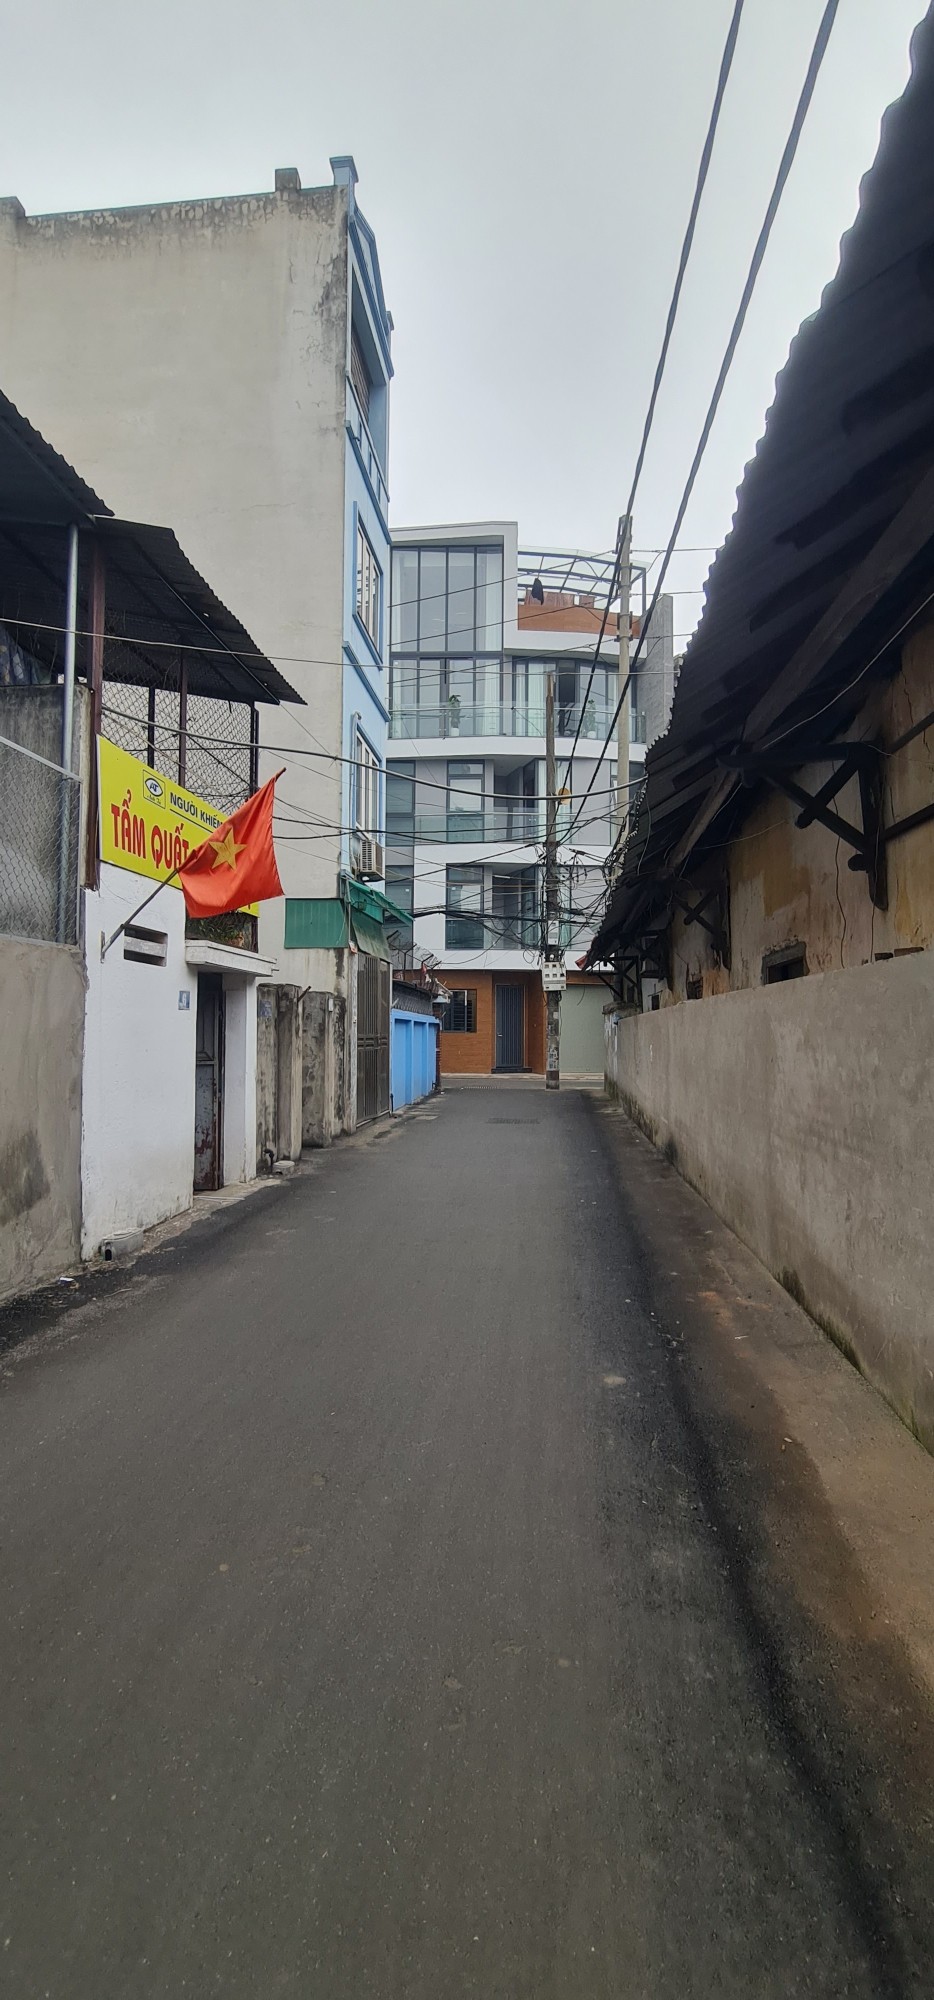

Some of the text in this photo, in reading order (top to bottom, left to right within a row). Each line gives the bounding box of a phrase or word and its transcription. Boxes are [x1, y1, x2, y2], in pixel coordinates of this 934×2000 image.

[111, 789, 189, 869] TẨM QUẤT
[170, 792, 198, 818] NGƯỜI
